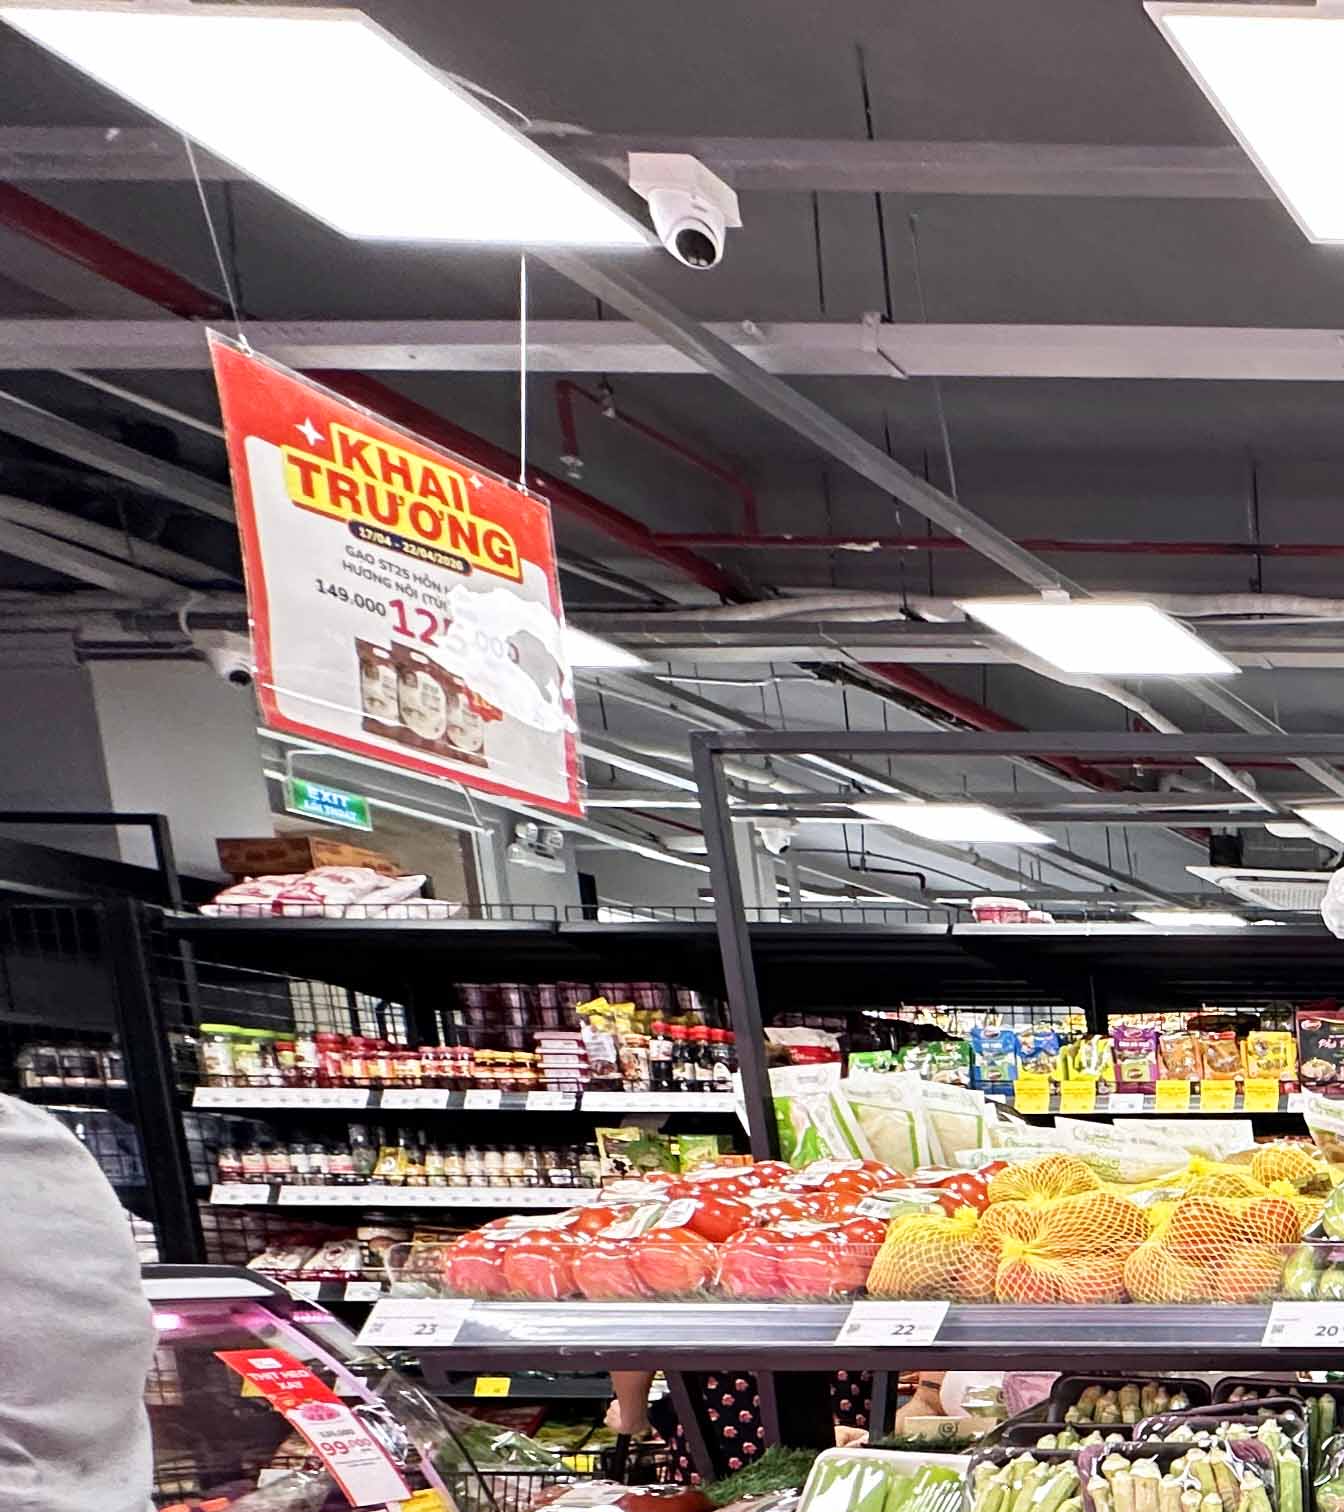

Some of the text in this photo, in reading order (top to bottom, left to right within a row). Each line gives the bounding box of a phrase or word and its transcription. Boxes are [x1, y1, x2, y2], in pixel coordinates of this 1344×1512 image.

[337, 431, 464, 512] KHAI
[286, 453, 514, 569] TRƯƠNG
[315, 578, 387, 617] 149.000
[413, 1323, 439, 1336] 23
[891, 1324, 916, 1336] 22
[1314, 1325, 1339, 1337] 20
